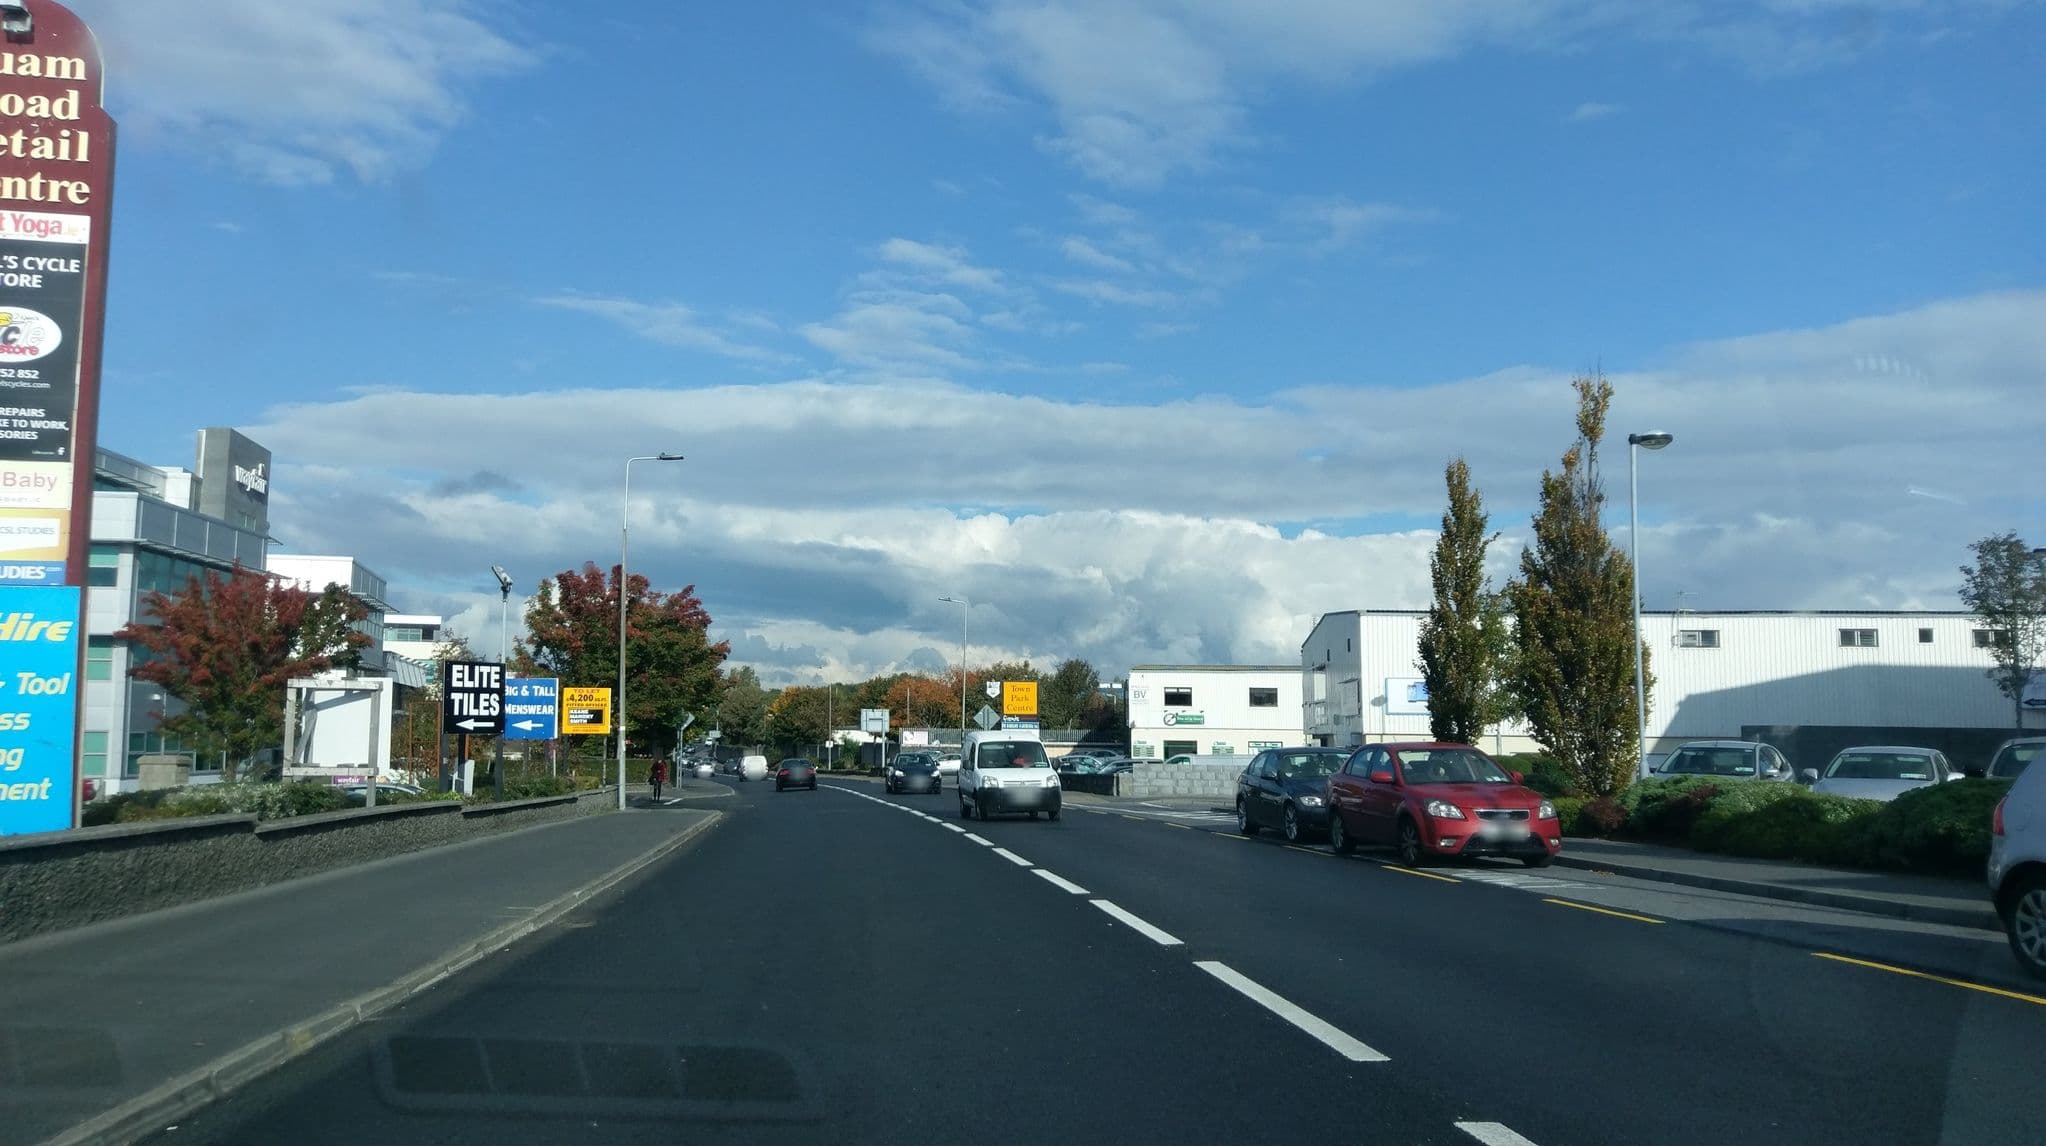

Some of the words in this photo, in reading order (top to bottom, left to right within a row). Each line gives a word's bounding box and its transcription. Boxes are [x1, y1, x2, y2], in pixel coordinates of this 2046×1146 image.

[0, 89, 80, 120] oad
[11, 213, 62, 238] Yoga
[23, 256, 80, 272] CYCLE
[0, 369, 15, 378] 52
[17, 370, 39, 379] 852
[0, 407, 46, 418] REPAIRS
[11, 420, 28, 428] TO
[3, 471, 58, 491] Baby
[235, 463, 266, 493] wayfair
[16, 672, 70, 695] Tool
[452, 665, 500, 688] ELITE
[521, 686, 529, 696] &
[532, 686, 555, 696] TALL
[451, 693, 500, 716] TILES
[505, 704, 554, 715] MENSWEAR
